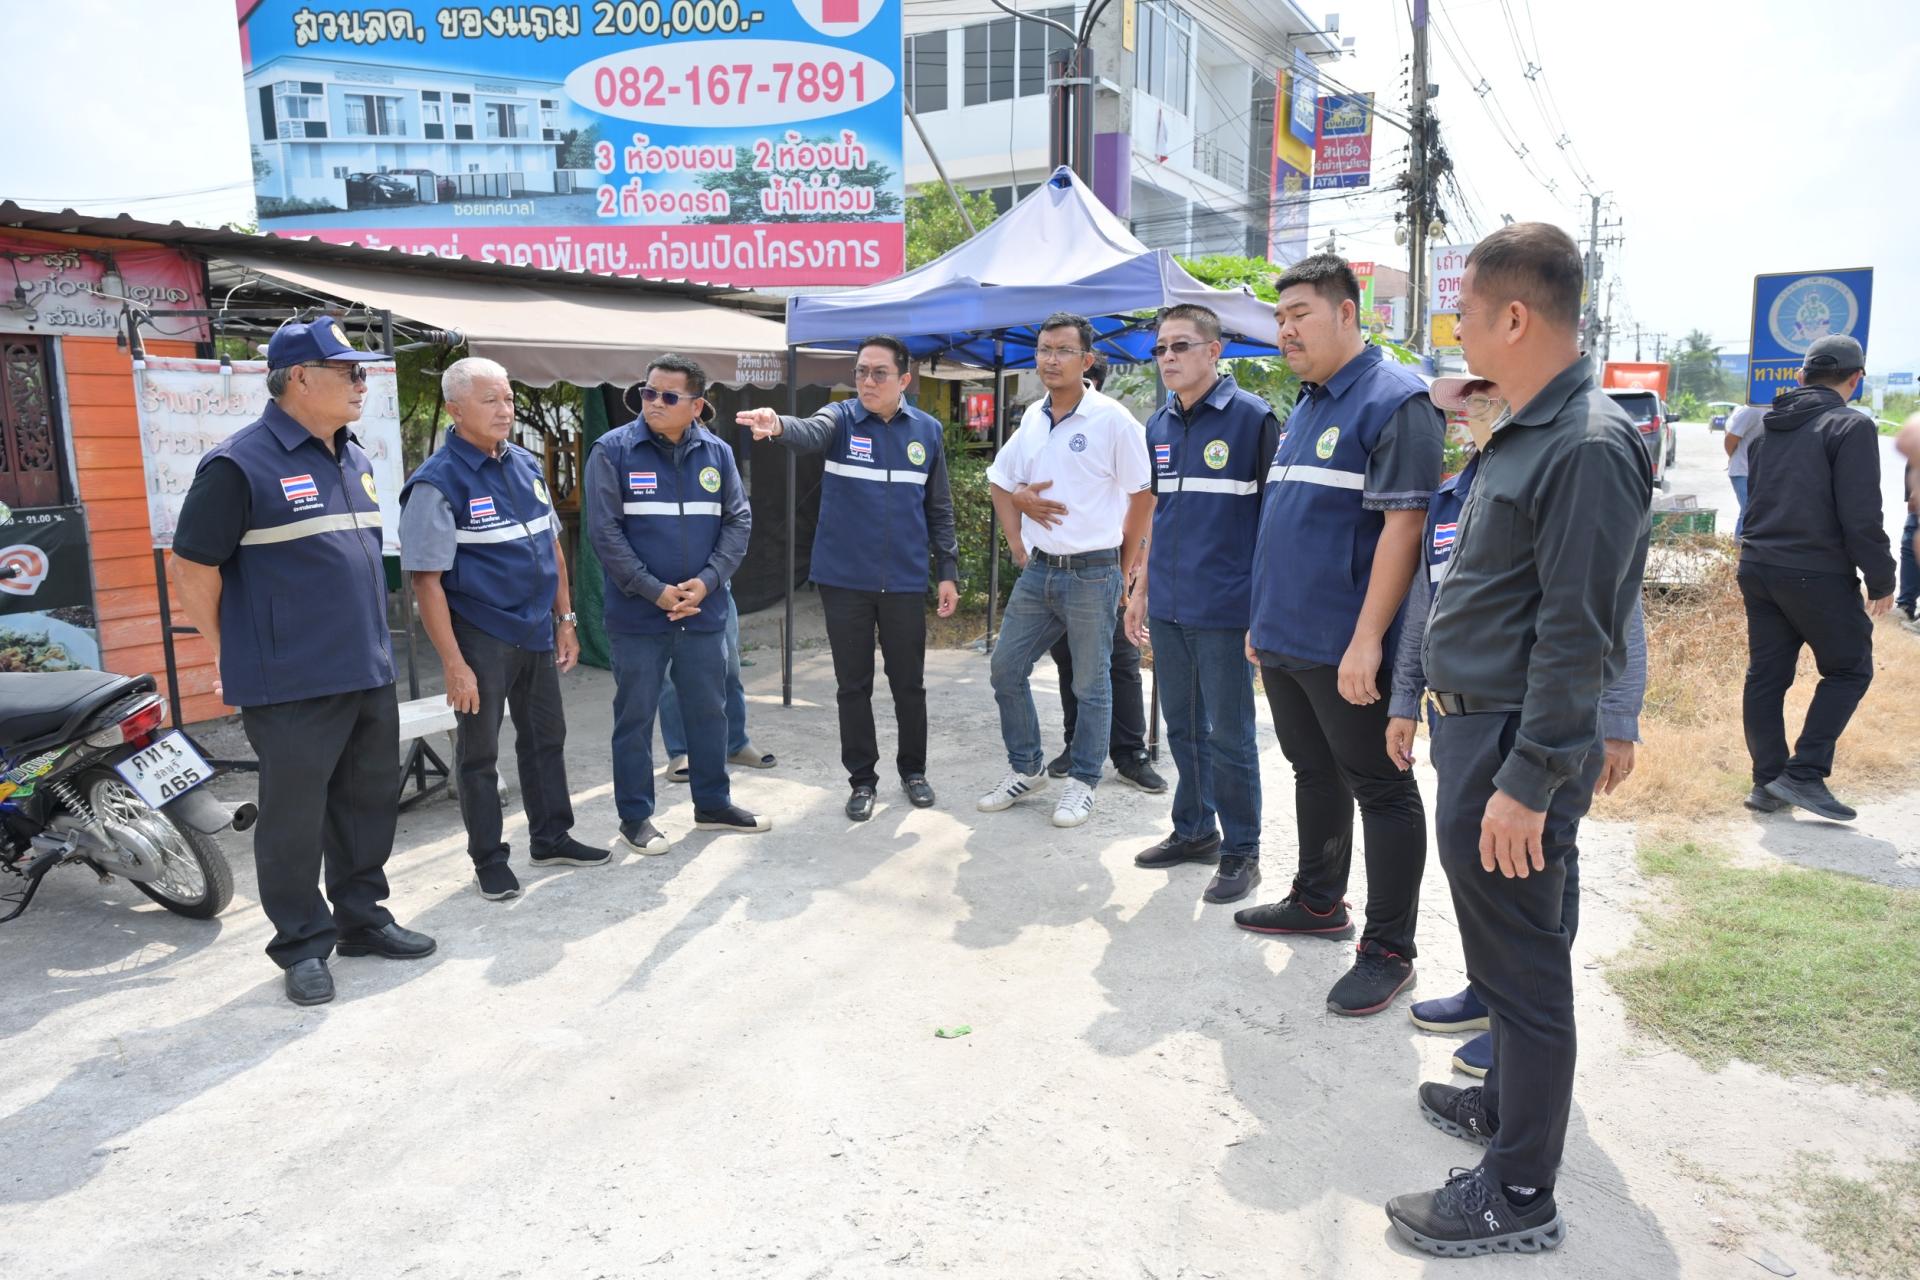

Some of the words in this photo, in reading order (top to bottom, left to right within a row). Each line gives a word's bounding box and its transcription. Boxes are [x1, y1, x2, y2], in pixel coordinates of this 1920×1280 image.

[437, 5, 579, 41] ของแถม
[594, 61, 865, 107] 082-167-7891
[598, 146, 612, 171] 3
[627, 136, 733, 169] ห้องนอน
[755, 142, 772, 169] 2
[779, 133, 865, 169] ห้องน้ำ
[601, 188, 615, 213] 2
[622, 180, 727, 213] ที่จอดรถ
[764, 178, 872, 212] น้ำไม่ท่วม
[1315, 177, 1338, 187] ATM
[1350, 263, 1371, 274] ini
[160, 768, 200, 799] 465
